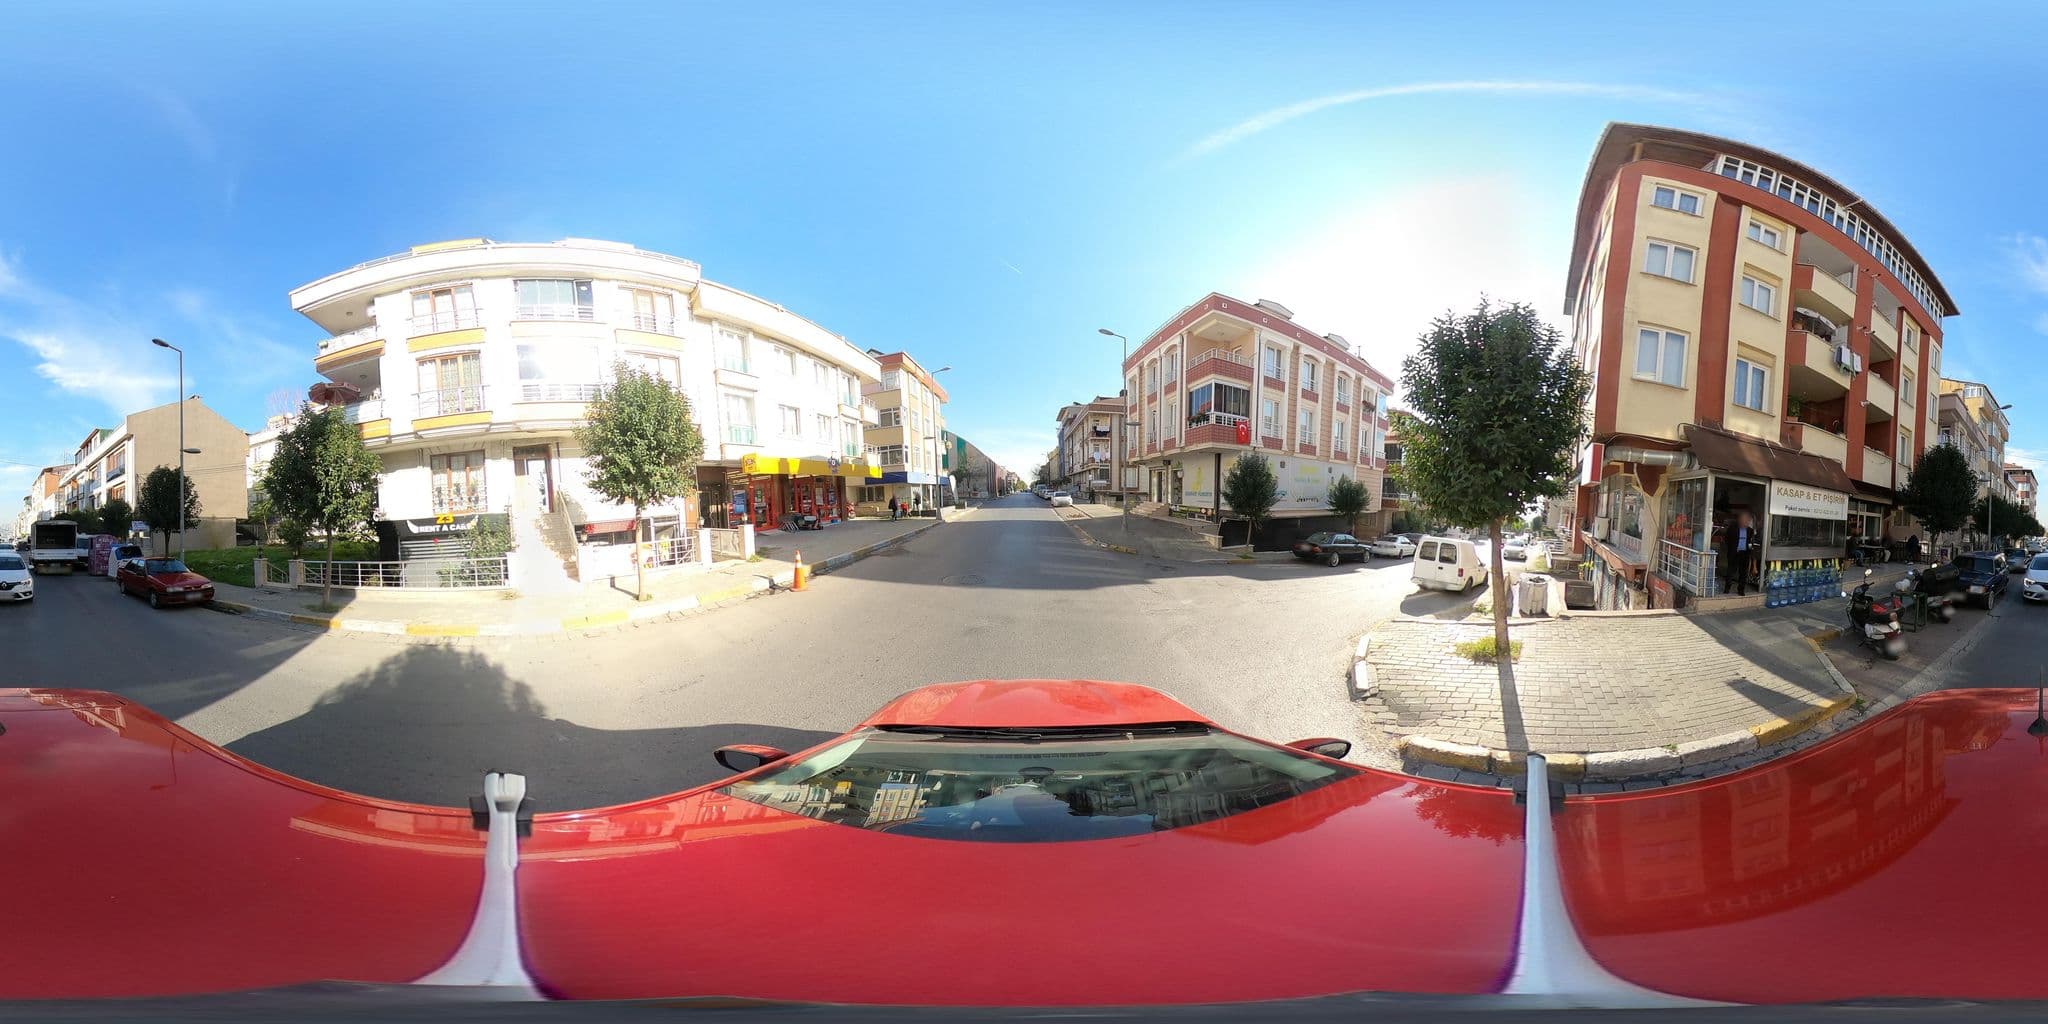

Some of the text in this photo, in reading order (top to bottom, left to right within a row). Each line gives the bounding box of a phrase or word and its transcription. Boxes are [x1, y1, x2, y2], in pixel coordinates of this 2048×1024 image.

[1776, 487, 1805, 498] KASAP
[1806, 492, 1812, 500] &
[1813, 492, 1822, 501] ET
[449, 523, 467, 531] CAR
